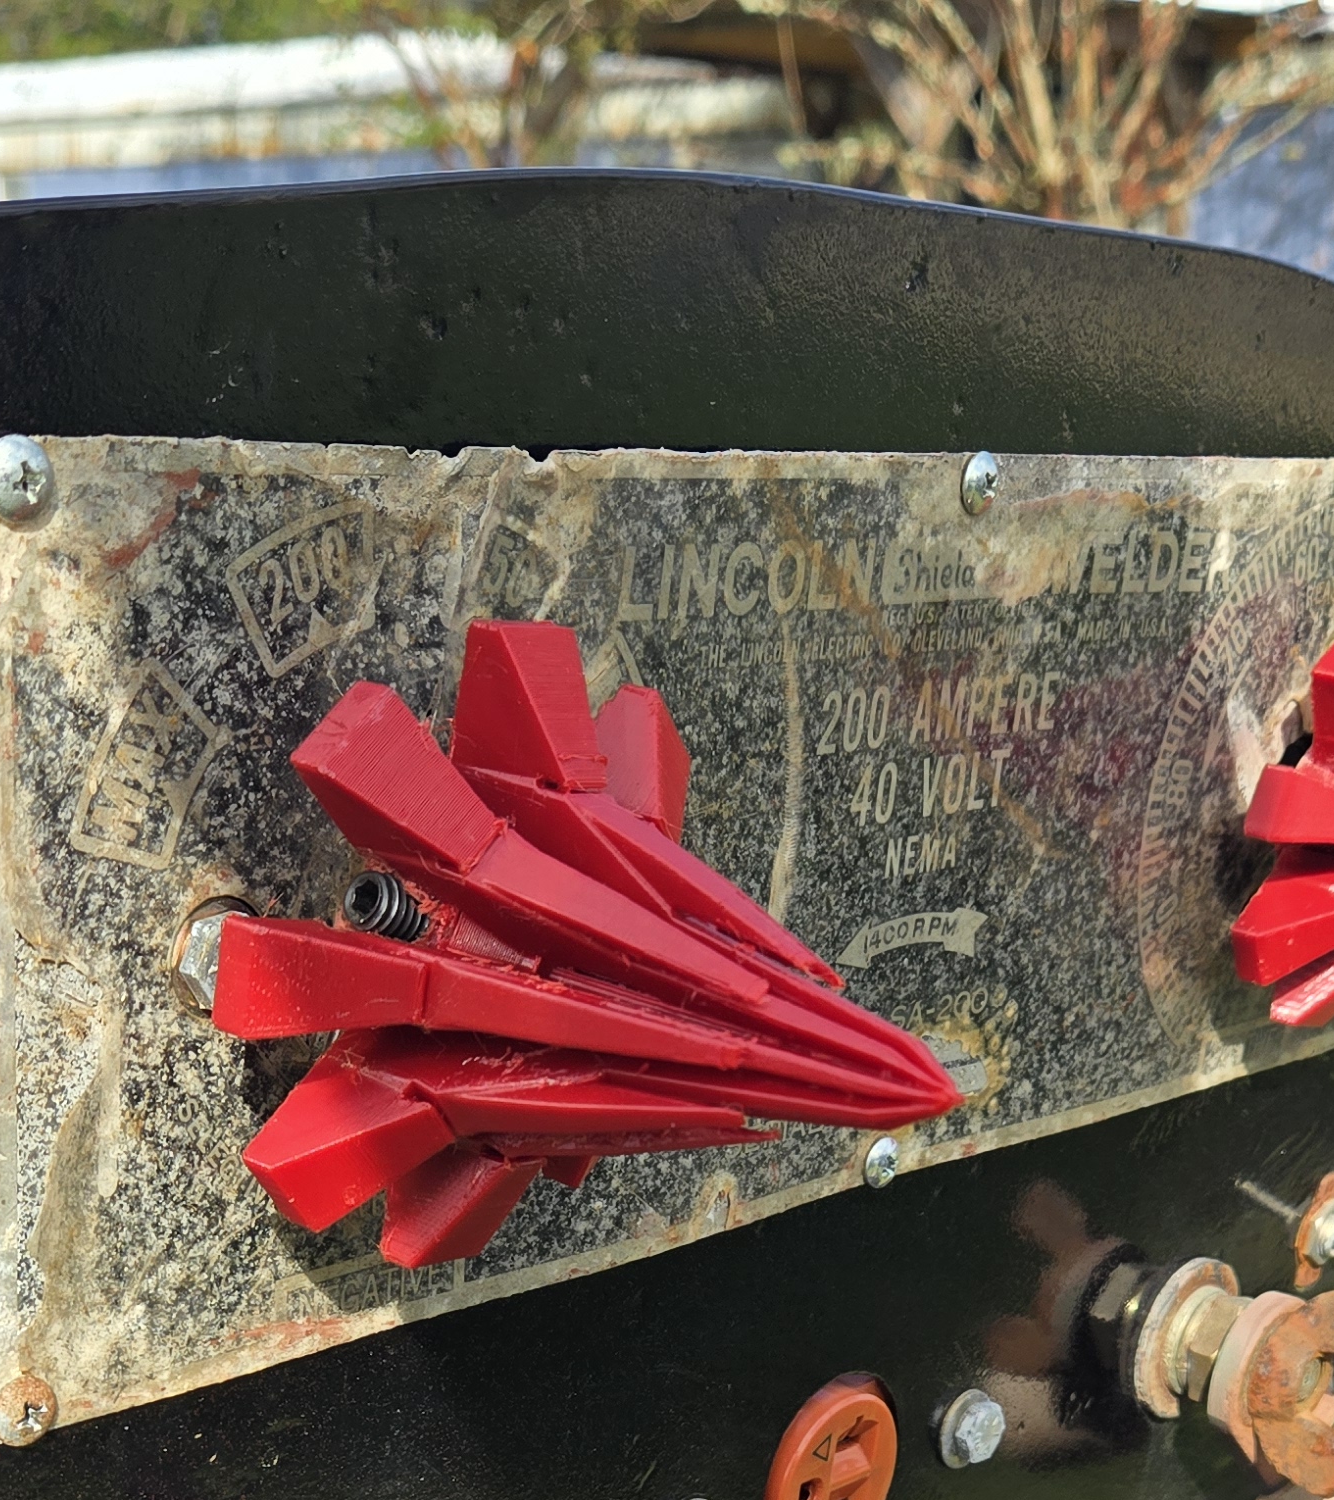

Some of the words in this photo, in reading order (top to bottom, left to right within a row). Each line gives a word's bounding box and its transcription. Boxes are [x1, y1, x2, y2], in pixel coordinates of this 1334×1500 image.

[256, 527, 350, 626] 200
[618, 539, 877, 621] LINCOLN
[1294, 535, 1321, 588] 60
[946, 602, 990, 622] PATENT
[994, 599, 1038, 619] OFFICE
[699, 644, 727, 669] THE
[740, 638, 801, 667] LINCOLN
[811, 633, 875, 662] ELECTRIC
[1076, 618, 1112, 642] MADE
[1118, 617, 1133, 640] IN
[1220, 618, 1248, 675] 70
[816, 684, 892, 757] 200
[909, 671, 1061, 745] AMPERE
[94, 697, 188, 843] MAX
[849, 761, 898, 827] 40
[922, 748, 1011, 819] VOLT
[1166, 757, 1194, 807] 80
[883, 832, 958, 879] NEMA
[889, 986, 990, 1030] SA-200
[285, 1264, 442, 1322] NEGATIVE
